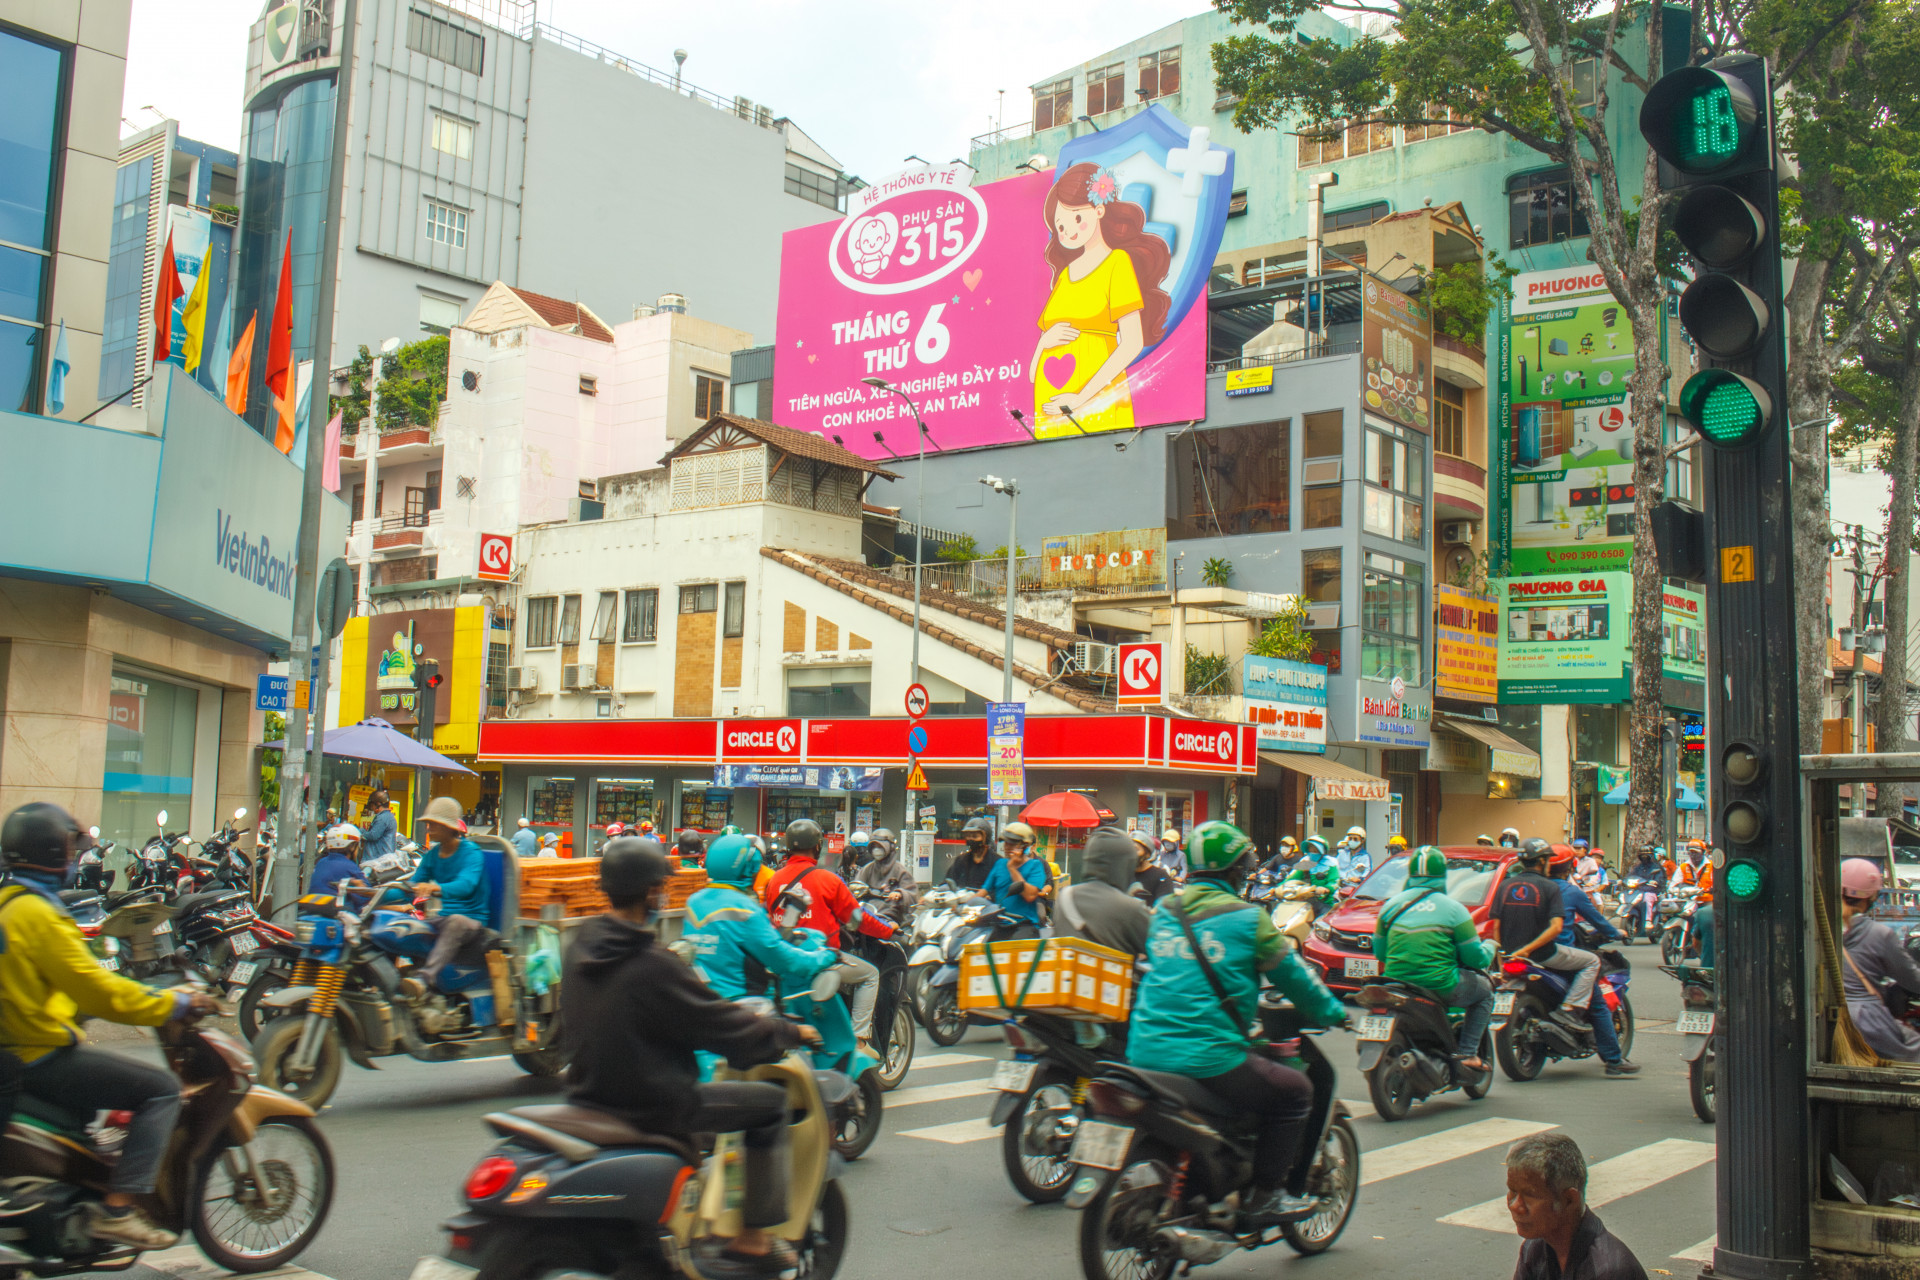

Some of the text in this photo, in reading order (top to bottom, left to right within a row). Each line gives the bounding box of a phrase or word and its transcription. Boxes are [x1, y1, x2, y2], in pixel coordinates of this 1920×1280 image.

[863, 168, 957, 205] HỆ THỐNG Y TẾ
[902, 200, 965, 227] PHỤ SẢN
[899, 217, 964, 266] 315
[1528, 273, 1605, 296] PHƯƠNG
[1536, 311, 1554, 321] CHIẾU
[1555, 310, 1573, 319] SÁNG
[832, 302, 950, 364] THÁNG 6
[863, 338, 910, 374] THỨ
[789, 393, 820, 412] TIÊM
[823, 387, 866, 408] NGỪA,
[901, 372, 958, 394] NGHIỆM
[962, 365, 995, 386] ĐẦY
[999, 359, 1022, 380] ĐỦ
[822, 412, 852, 428] CON
[857, 401, 894, 423] KHOẺ
[924, 398, 945, 414] AN
[949, 391, 980, 410] TÂM
[1586, 397, 1608, 405] PHÒNG
[1536, 473, 1550, 481] NHÀ
[217, 508, 294, 600] VietinBank
[1050, 549, 1155, 572] PHOTOCOPY
[1560, 549, 1625, 560] 090 390 6508
[1732, 553, 1744, 575] 2
[1509, 579, 1607, 596] PHƯƠNG GIA
[1276, 668, 1325, 690] PHOTOCOPY
[261, 695, 278, 707] CAO
[380, 693, 415, 711] 100 VỊ
[1363, 697, 1384, 716] Bánh
[1385, 697, 1399, 717] Ướt
[1401, 702, 1416, 720] Ban
[997, 715, 1015, 724] 1789
[728, 731, 774, 747] CIRCLE
[778, 728, 796, 750] K
[1175, 733, 1215, 753] CIRCLE
[760, 774, 777, 782] GAME
[763, 765, 779, 773] CLEAR
[1002, 768, 1022, 777] TRIỆU
[1327, 783, 1386, 798] IN MÀU
[1354, 960, 1369, 969] 51H
